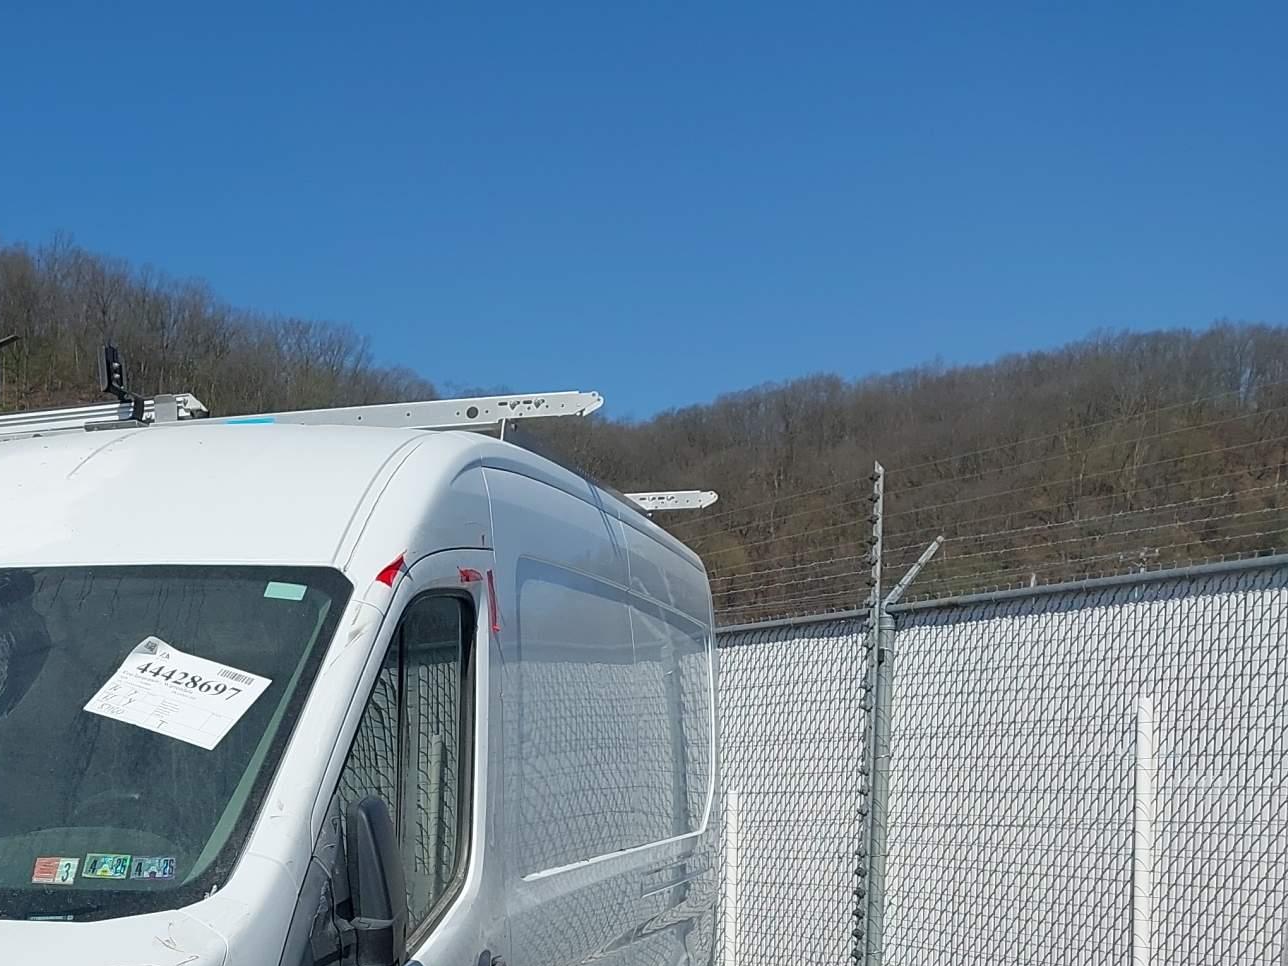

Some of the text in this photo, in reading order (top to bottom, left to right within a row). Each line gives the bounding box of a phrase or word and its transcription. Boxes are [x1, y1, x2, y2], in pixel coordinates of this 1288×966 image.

[136, 662, 243, 700] 44428697
[62, 862, 71, 882] 3
[88, 860, 98, 874] 4
[135, 862, 144, 876] 4
